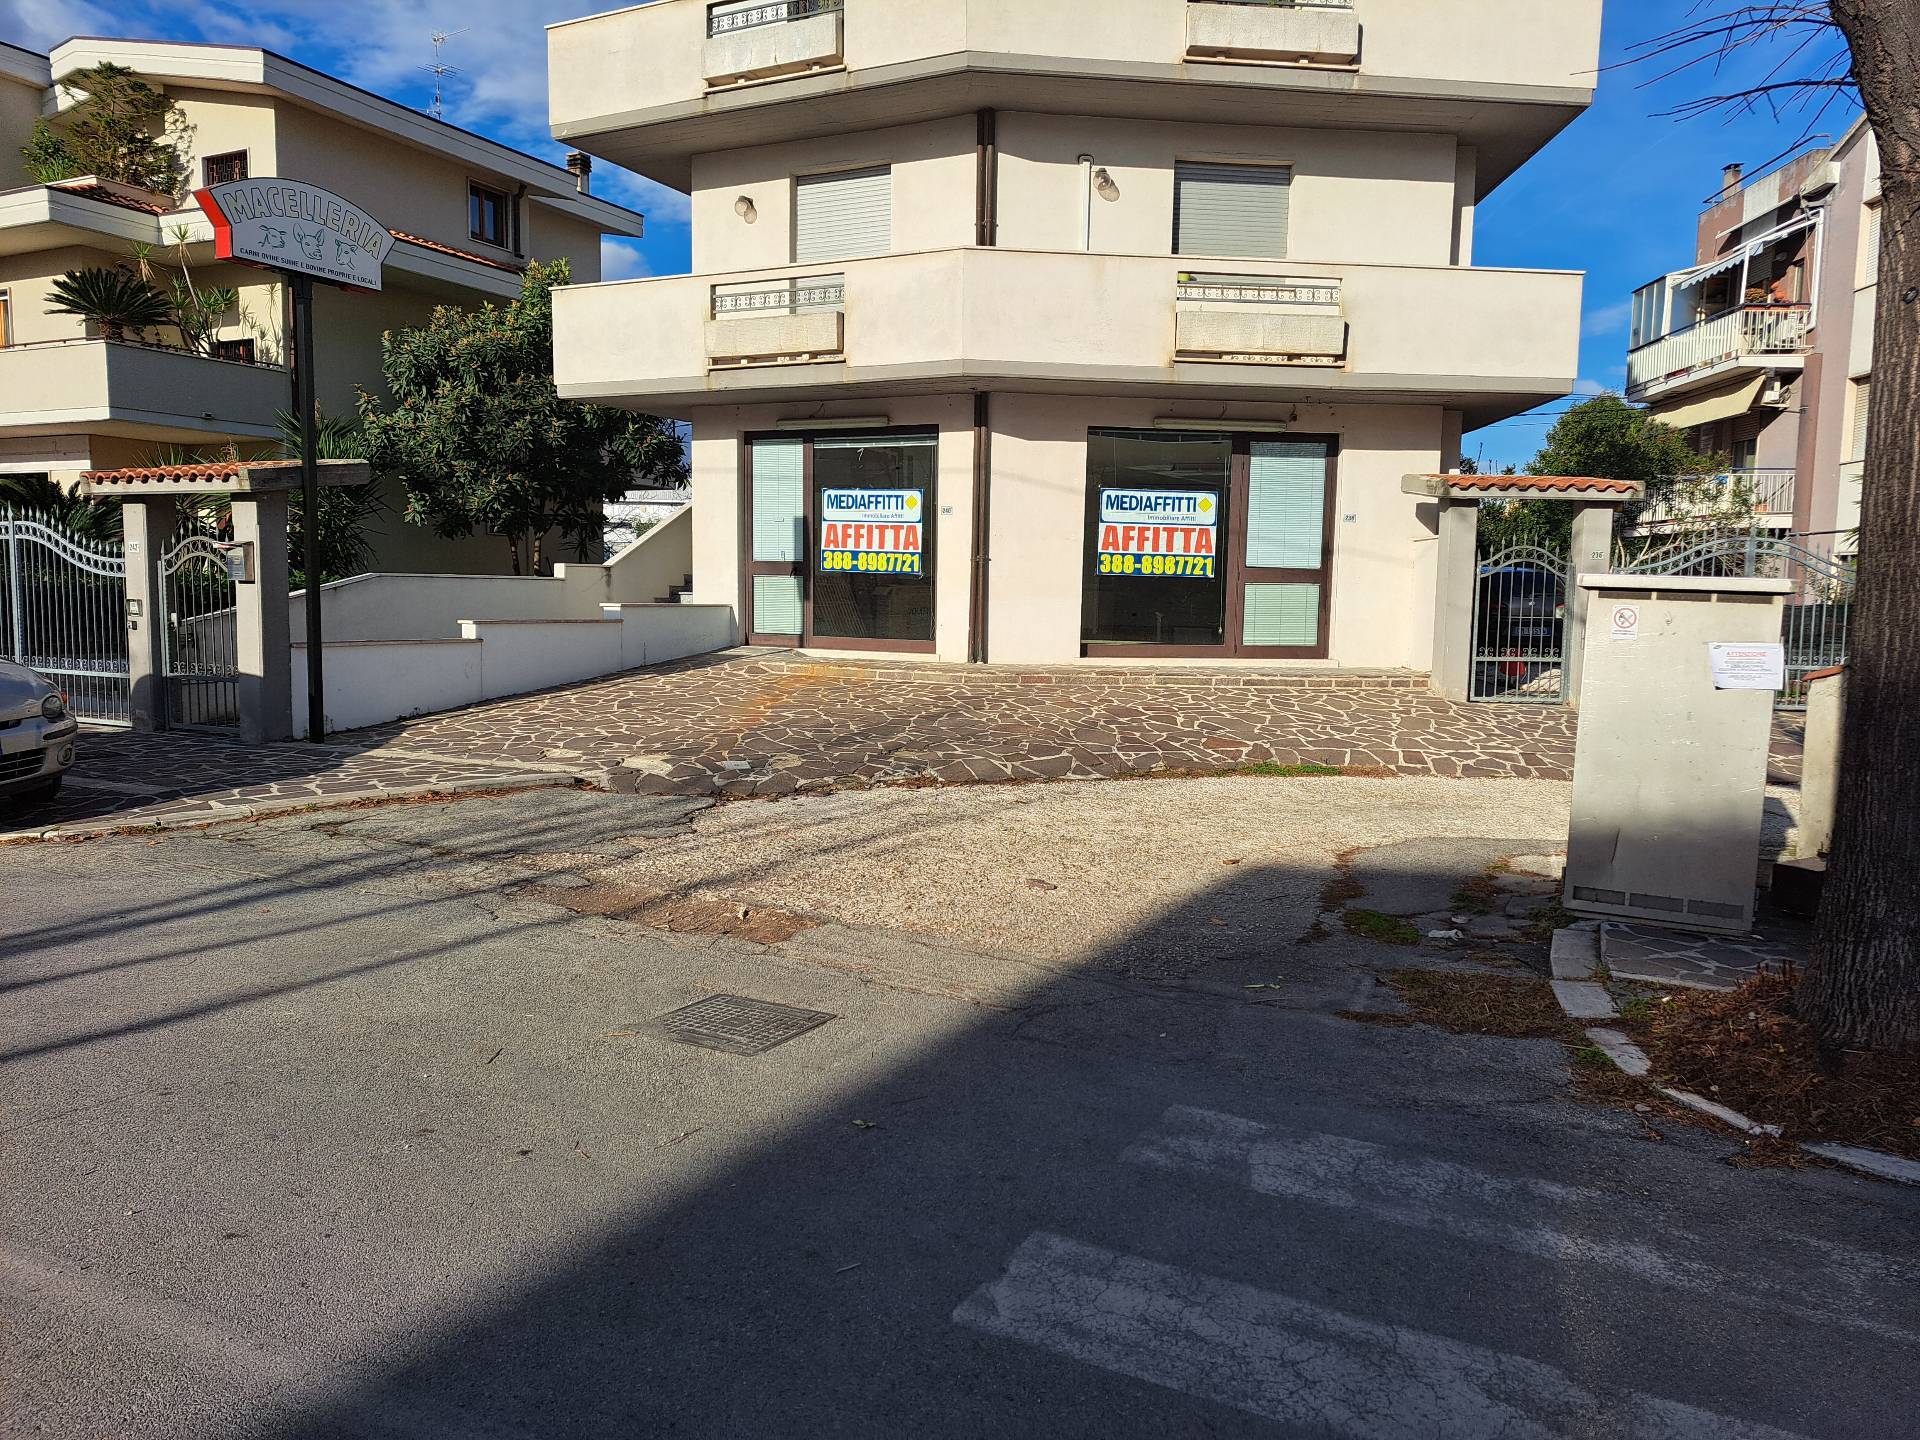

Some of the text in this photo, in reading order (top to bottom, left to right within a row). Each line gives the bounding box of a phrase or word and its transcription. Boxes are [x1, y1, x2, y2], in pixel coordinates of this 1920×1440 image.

[222, 186, 384, 260] MACELLERIA
[239, 247, 260, 258] CARNI
[261, 252, 280, 263] OVINE
[280, 257, 300, 267] SUINE
[305, 264, 327, 274] BOVINE
[327, 268, 352, 280] PROPRIE
[357, 276, 377, 286] LOCALI
[827, 494, 904, 510] MEDIAFFITTI
[1105, 494, 1197, 512] MEDIAFFITTI
[824, 524, 919, 550] AFFITTA
[1101, 525, 1213, 553] AFFITTA
[823, 551, 919, 572] 388-8987721
[1100, 554, 1213, 575] 388-8987721
